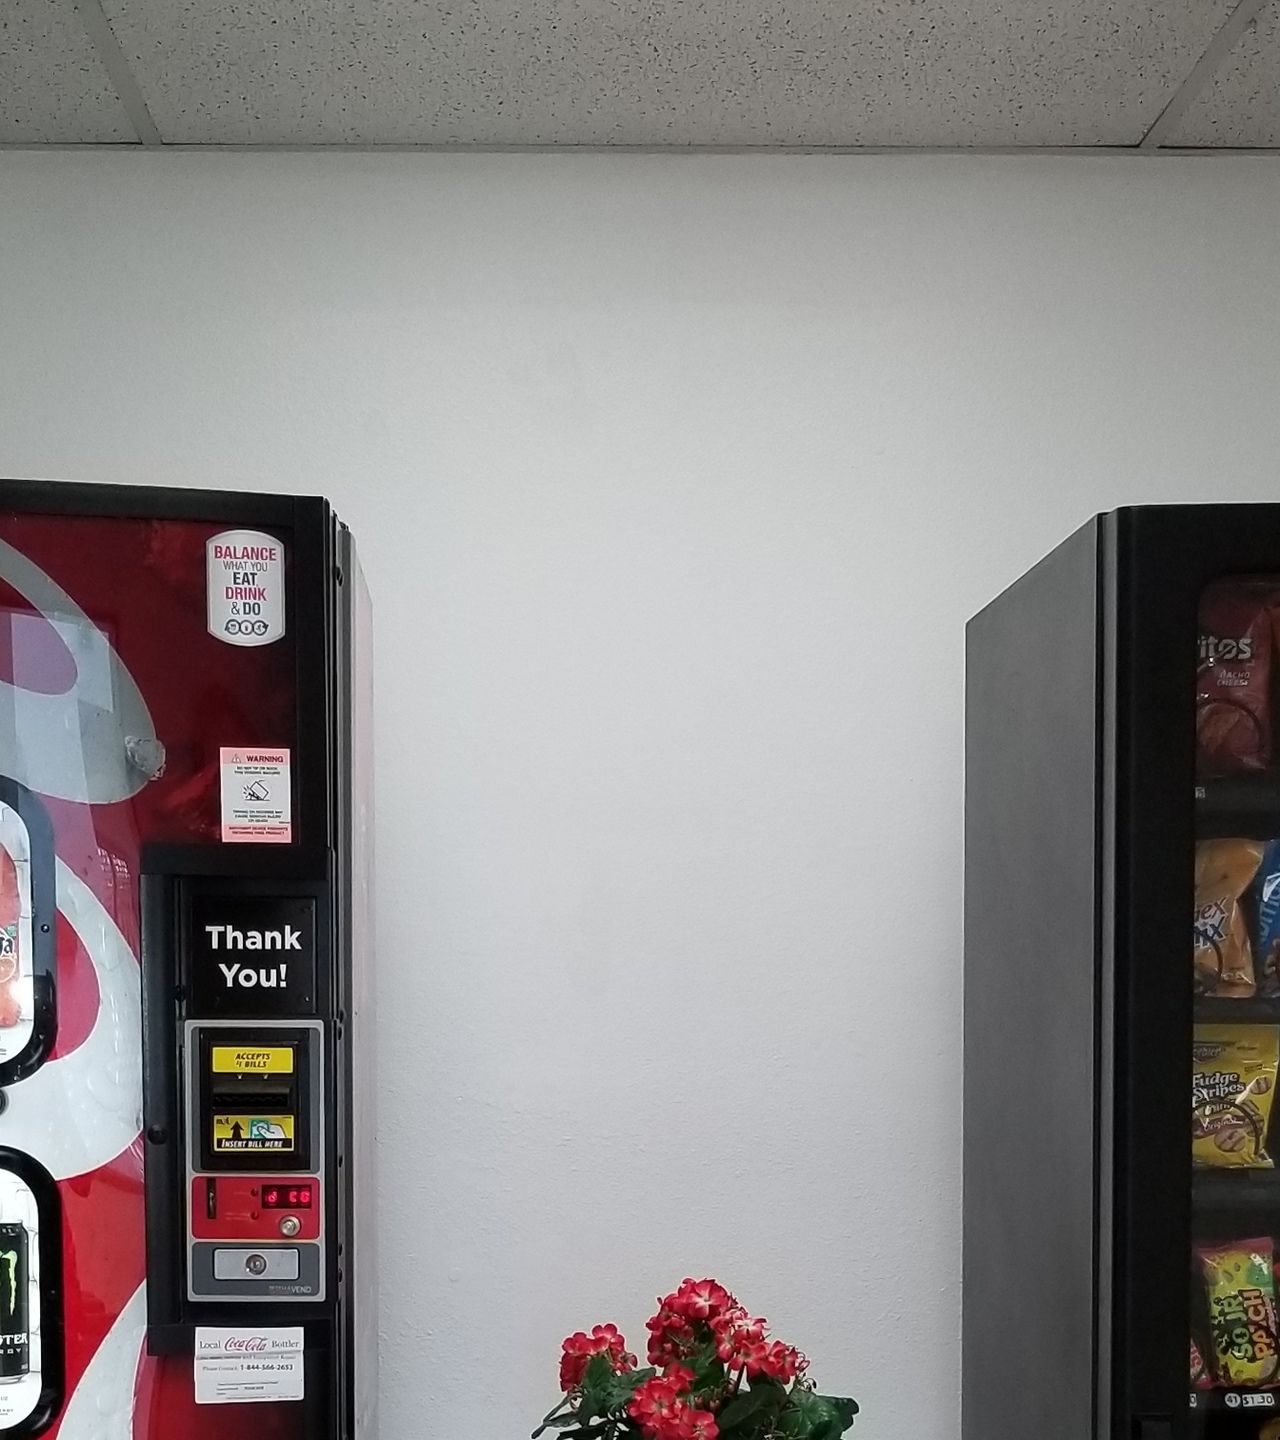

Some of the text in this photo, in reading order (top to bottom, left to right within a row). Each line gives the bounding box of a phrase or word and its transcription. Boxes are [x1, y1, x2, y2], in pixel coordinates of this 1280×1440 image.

[214, 545, 276, 561] BALANCE
[223, 560, 268, 572] WHAT YOU
[225, 586, 267, 601] DRINK
[231, 601, 261, 616] & DO
[1198, 636, 1252, 660] itos
[246, 755, 284, 763] WARNING
[205, 925, 302, 950] Thank
[218, 963, 287, 988] You!
[245, 1060, 267, 1068] BILLS
[1193, 1071, 1239, 1088] Fudge
[1193, 1082, 1246, 1101] Stripes
[221, 1139, 246, 1148] INSERT
[200, 1341, 221, 1349] Local
[272, 1340, 299, 1349] Bottler
